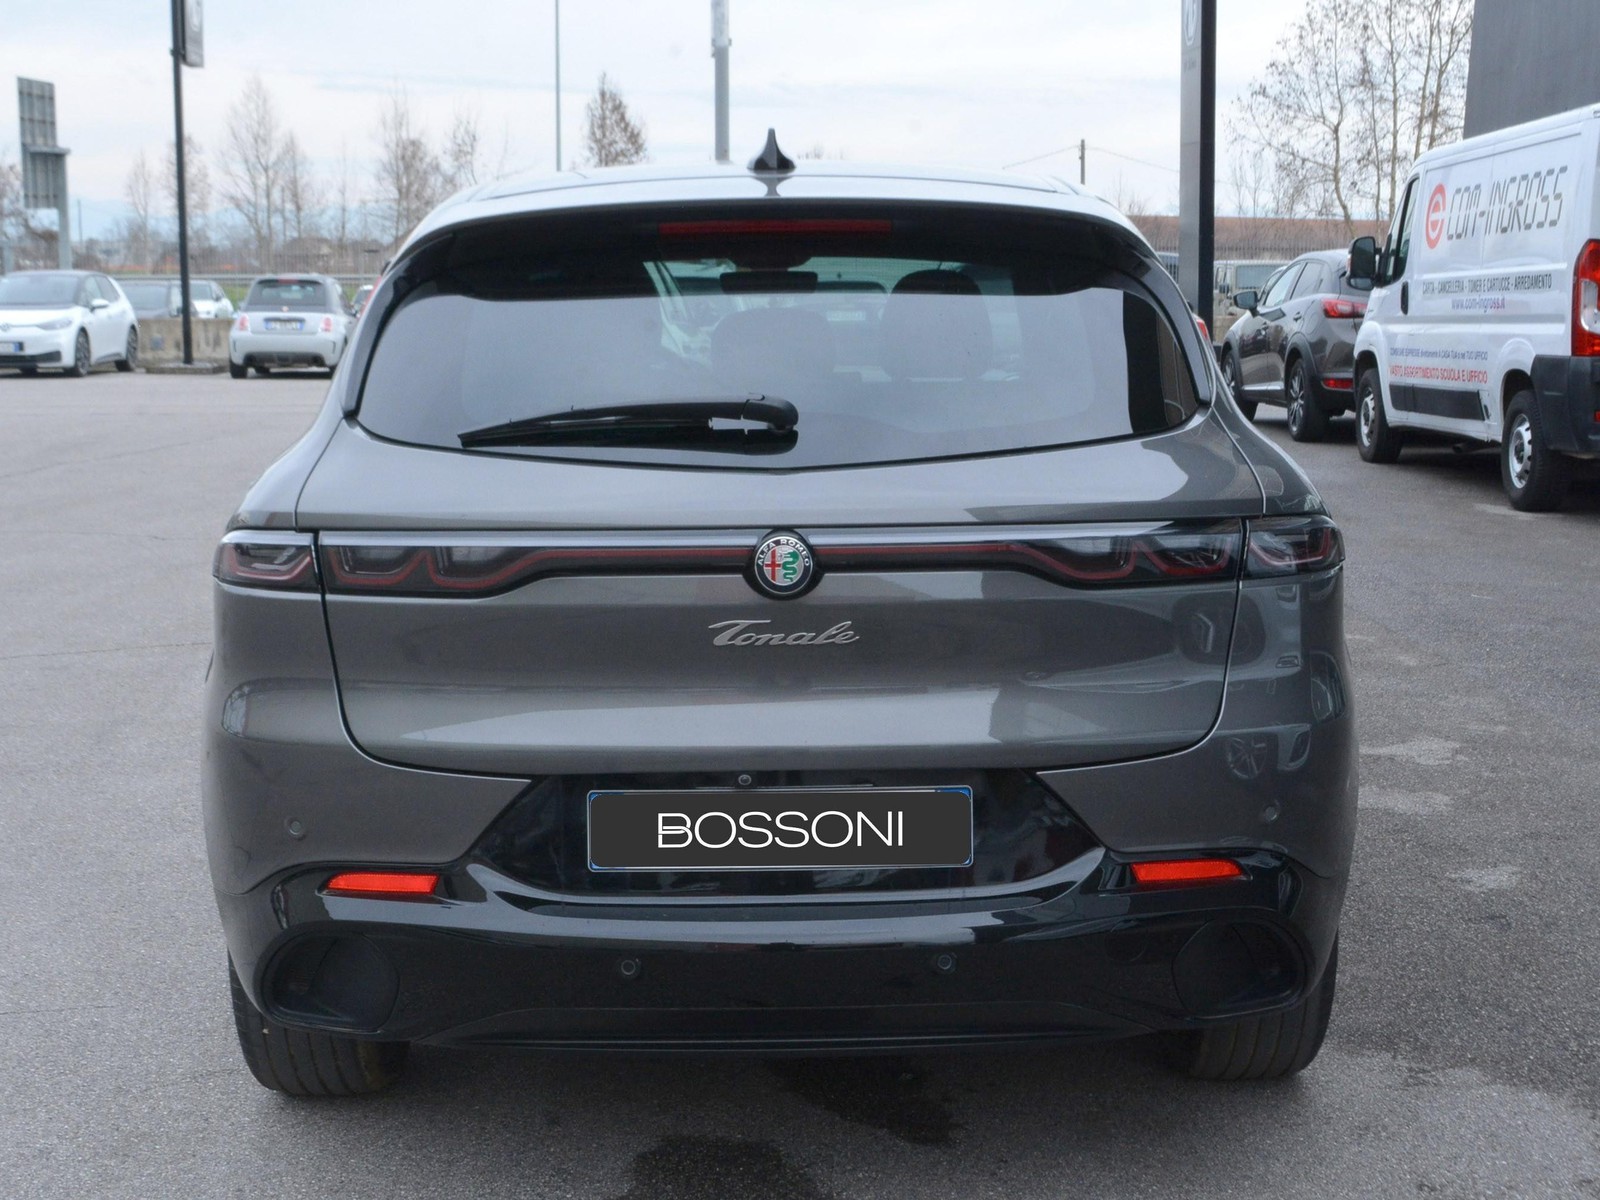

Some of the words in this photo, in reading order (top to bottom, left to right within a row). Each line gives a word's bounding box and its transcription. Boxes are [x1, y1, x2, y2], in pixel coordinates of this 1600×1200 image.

[1422, 281, 1435, 295] CARTA
[1438, 279, 1465, 294] CANCELLERIA
[1487, 276, 1510, 292] CARTUCCE
[1514, 273, 1552, 290] ARREDAMENTO
[1440, 367, 1460, 382] SCUOLA
[1467, 369, 1488, 384] UFFICIO
[757, 542, 776, 566] ALFA
[780, 538, 810, 566] ROMEO
[708, 619, 860, 647] Tonale
